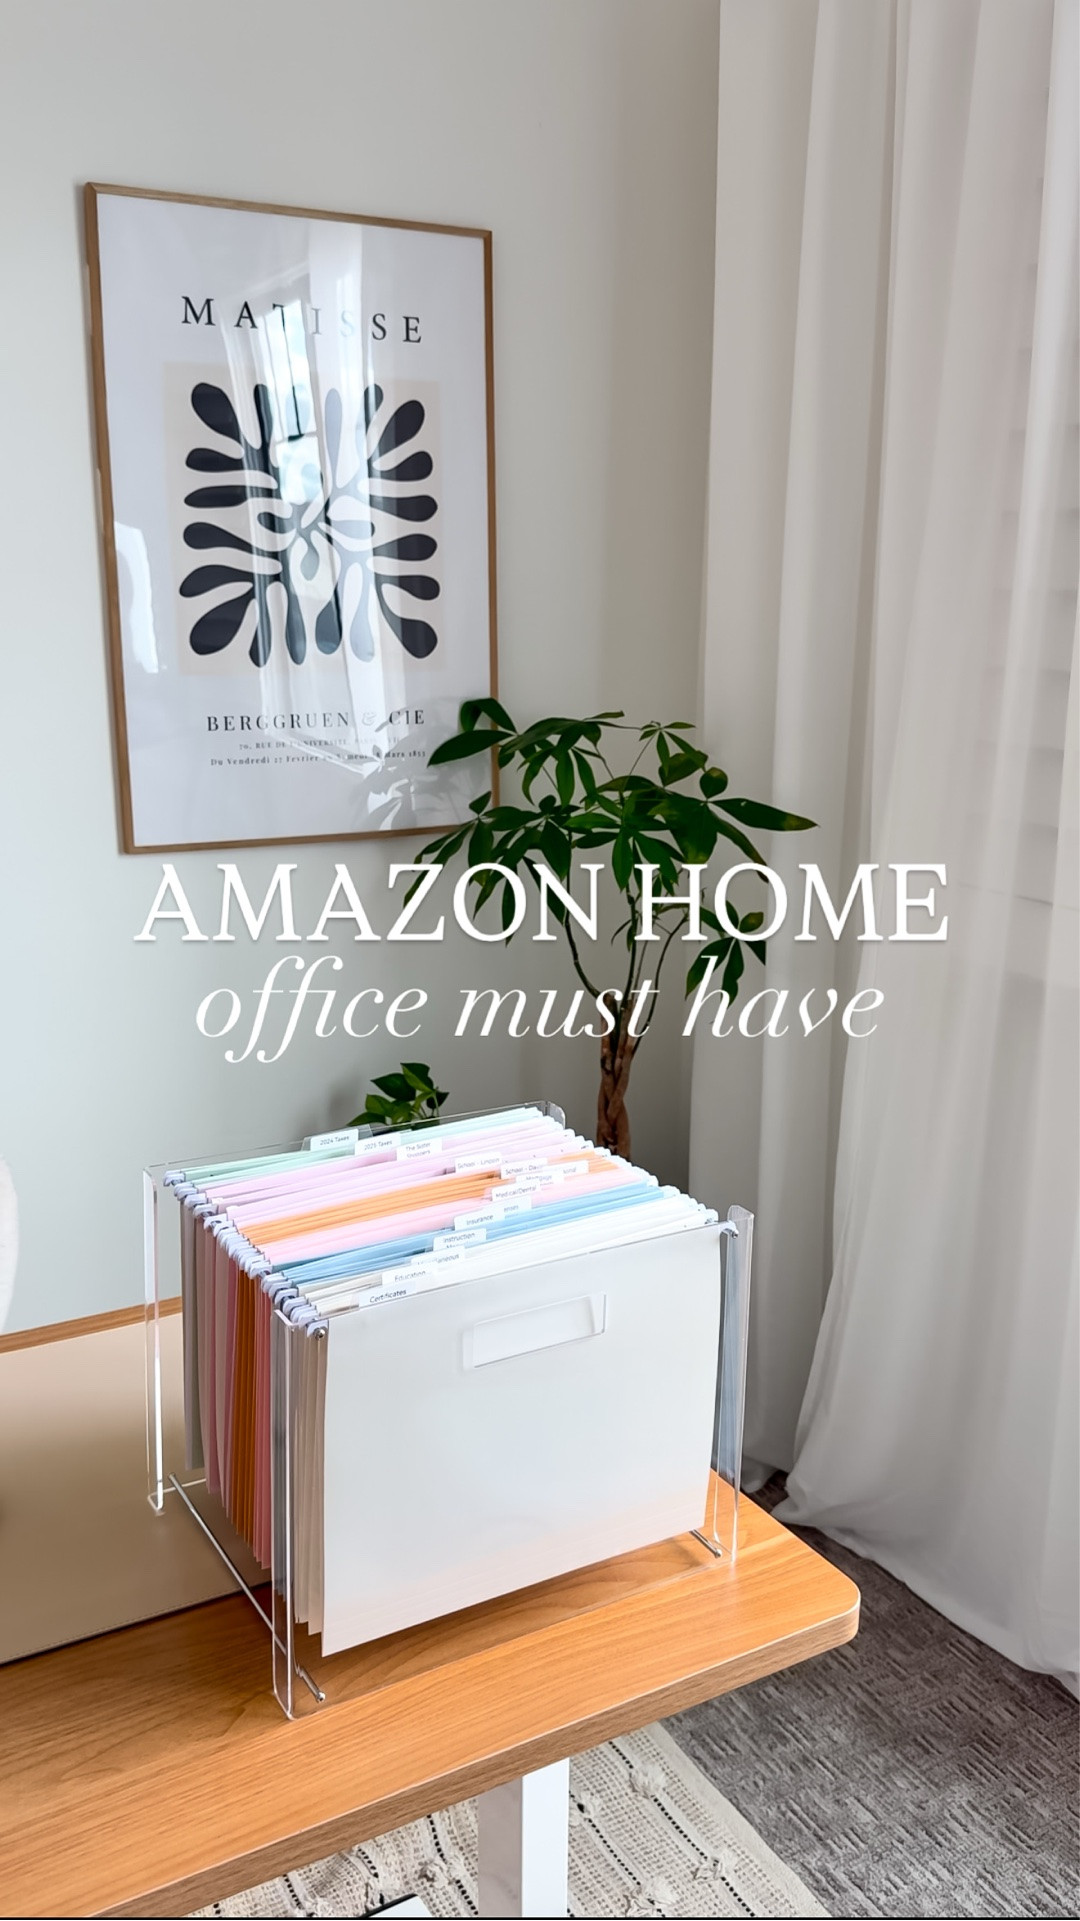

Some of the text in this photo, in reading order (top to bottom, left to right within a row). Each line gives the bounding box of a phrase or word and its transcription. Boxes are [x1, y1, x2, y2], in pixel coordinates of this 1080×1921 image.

[181, 295, 422, 344] MATISSE
[207, 712, 348, 732] BERGGRUEN
[389, 709, 425, 725] CIE
[210, 758, 223, 766] Du
[227, 756, 270, 765] Vendredi
[320, 1138, 334, 1146] 2024
[505, 1166, 522, 1176] School
[466, 1214, 494, 1226] Insurance
[443, 1232, 476, 1244] Instruction
[394, 1269, 426, 1282] Education
[369, 1288, 407, 1303] Certificates
